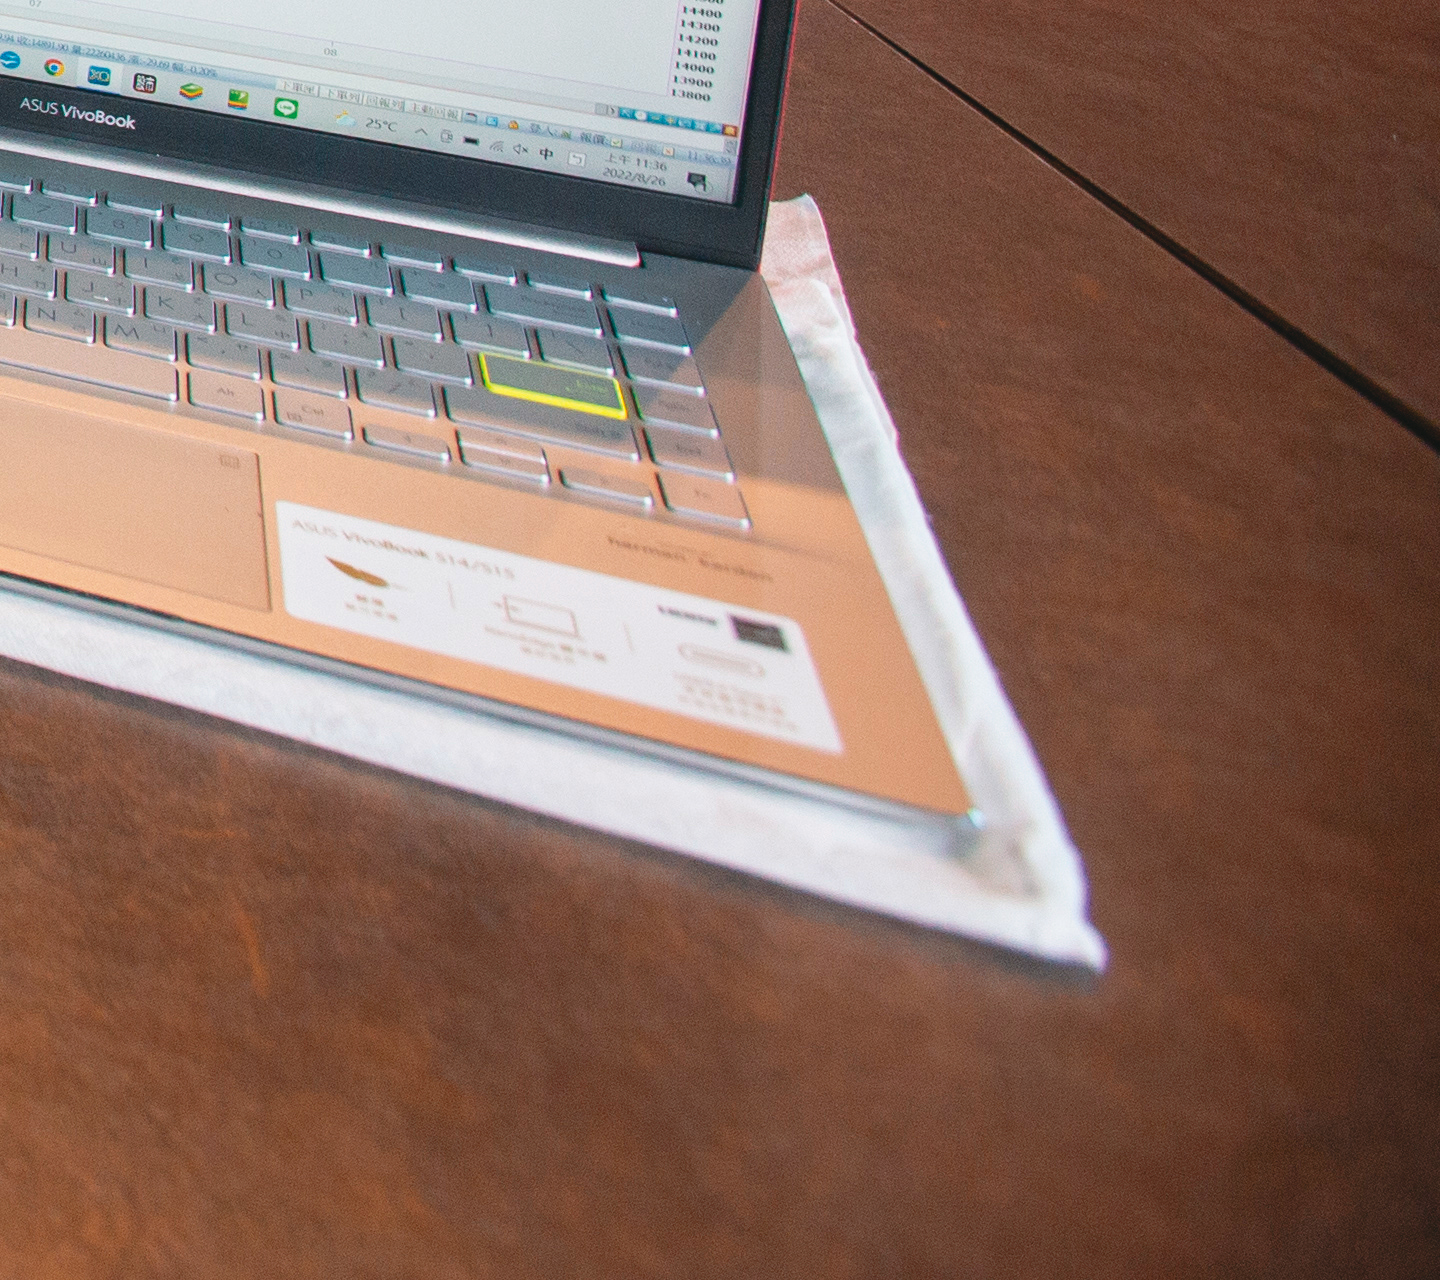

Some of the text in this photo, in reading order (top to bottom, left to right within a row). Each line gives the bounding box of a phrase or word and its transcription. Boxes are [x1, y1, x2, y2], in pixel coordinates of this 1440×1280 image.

[682, 6, 723, 19] 14400
[675, 61, 715, 74] 14000
[19, 96, 137, 131] ASUS VivoBook
[601, 165, 668, 189] 2022/8/26
